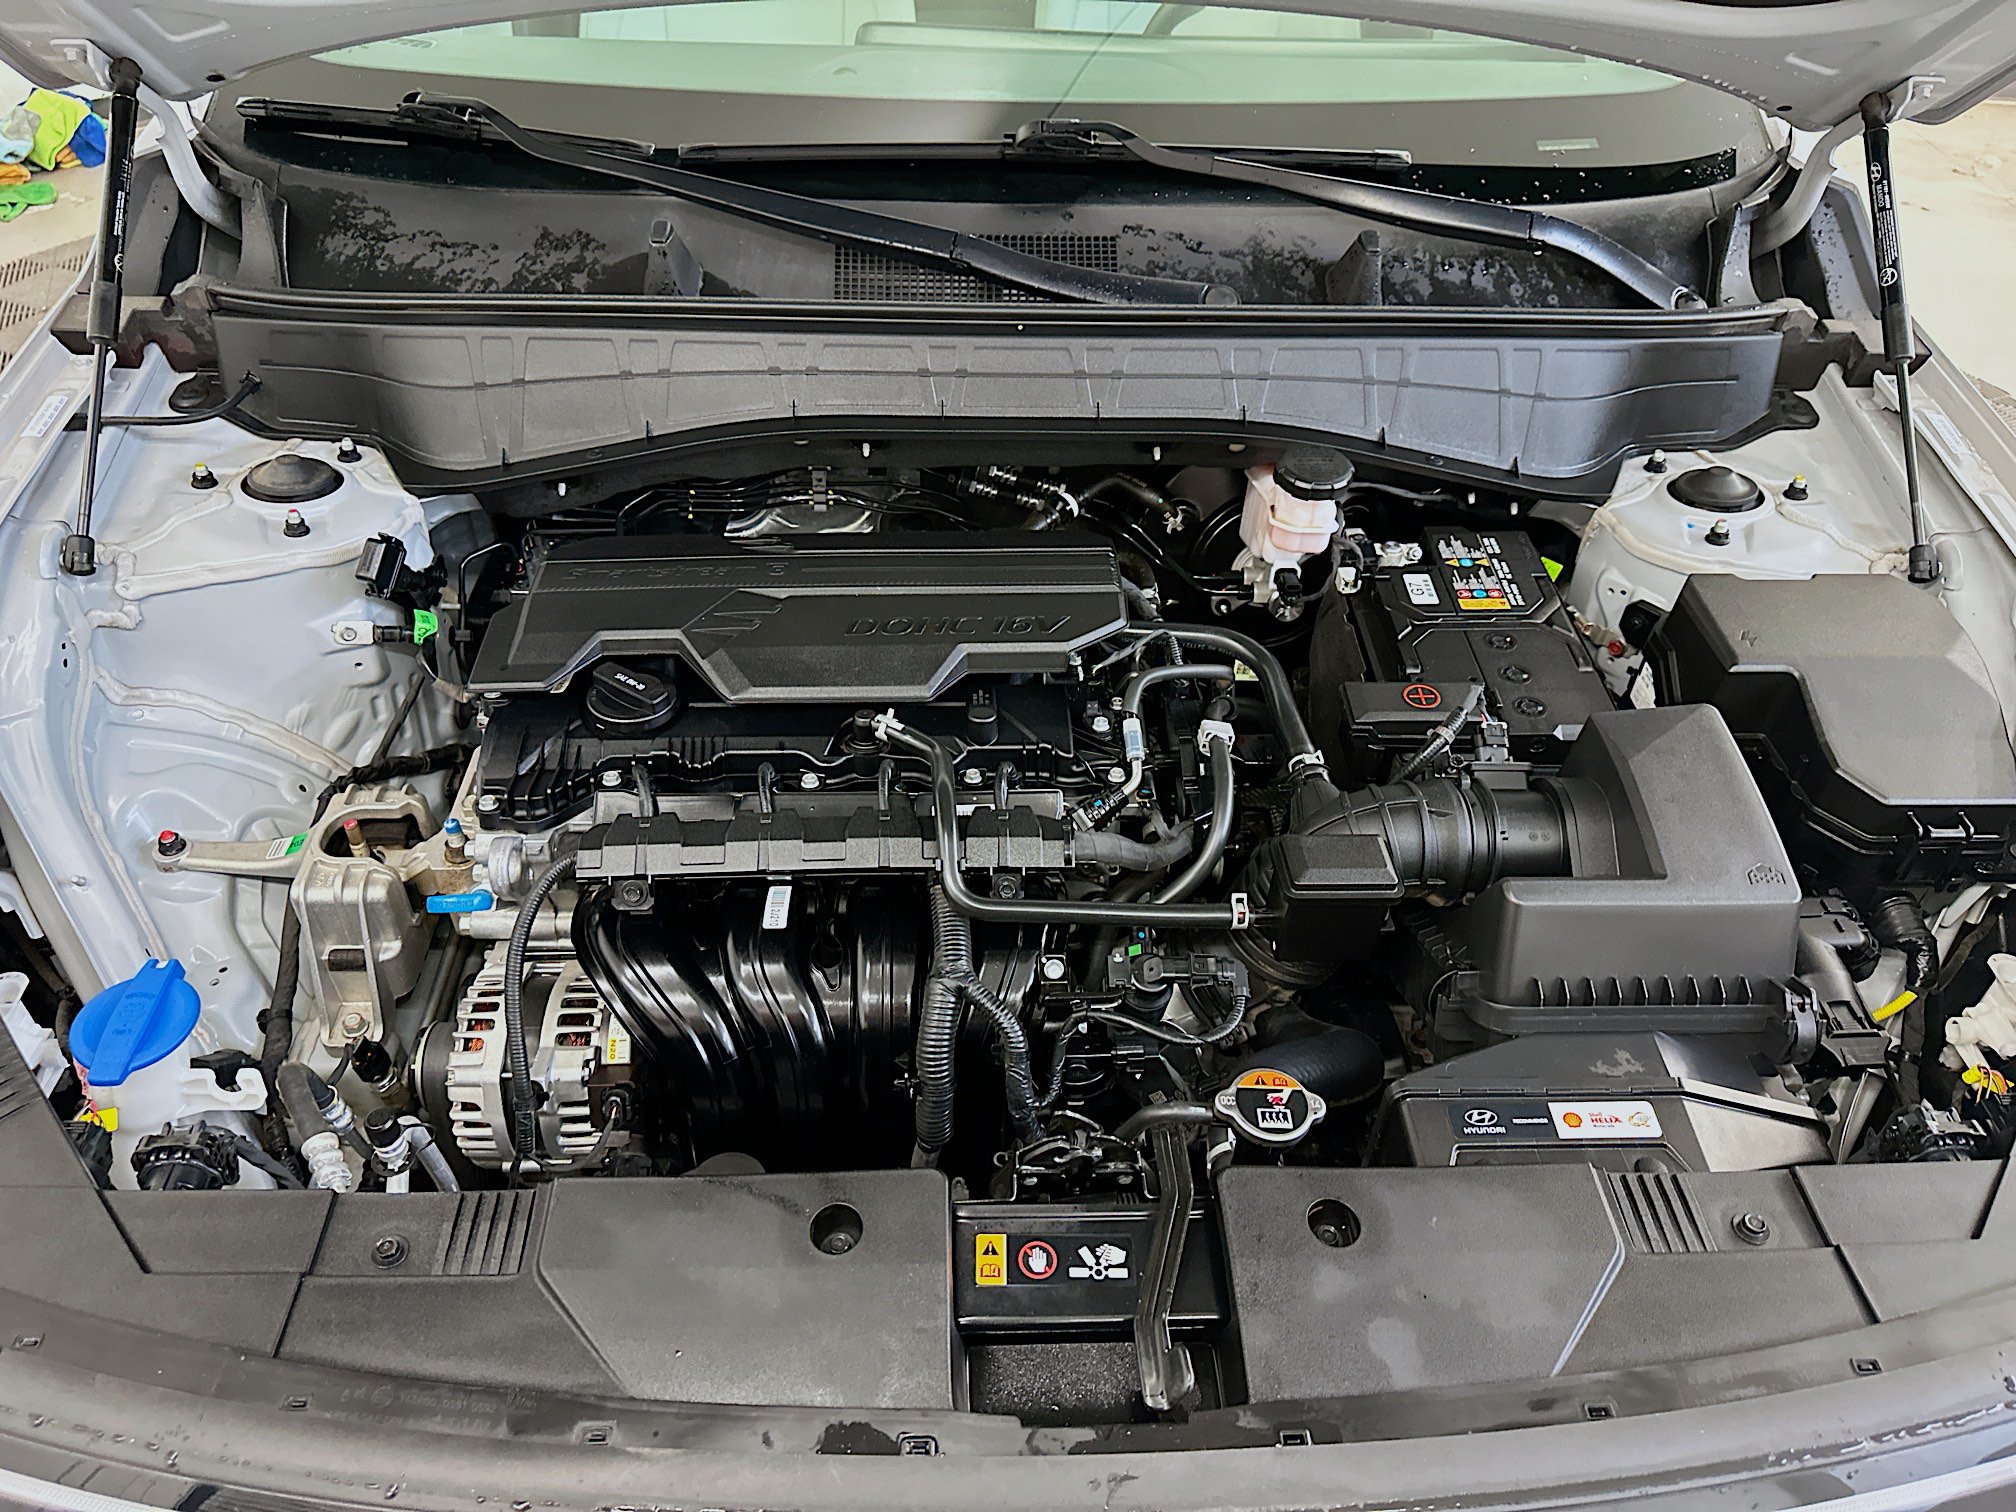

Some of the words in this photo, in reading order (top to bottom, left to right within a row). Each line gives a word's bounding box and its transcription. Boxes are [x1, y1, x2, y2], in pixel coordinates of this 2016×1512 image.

[1410, 582, 1423, 597] G7
[844, 615, 983, 637] DOHC
[993, 614, 1072, 635] 16V
[1590, 1116, 1622, 1124] HELIX
[1464, 1127, 1506, 1135] HYUNDAI
